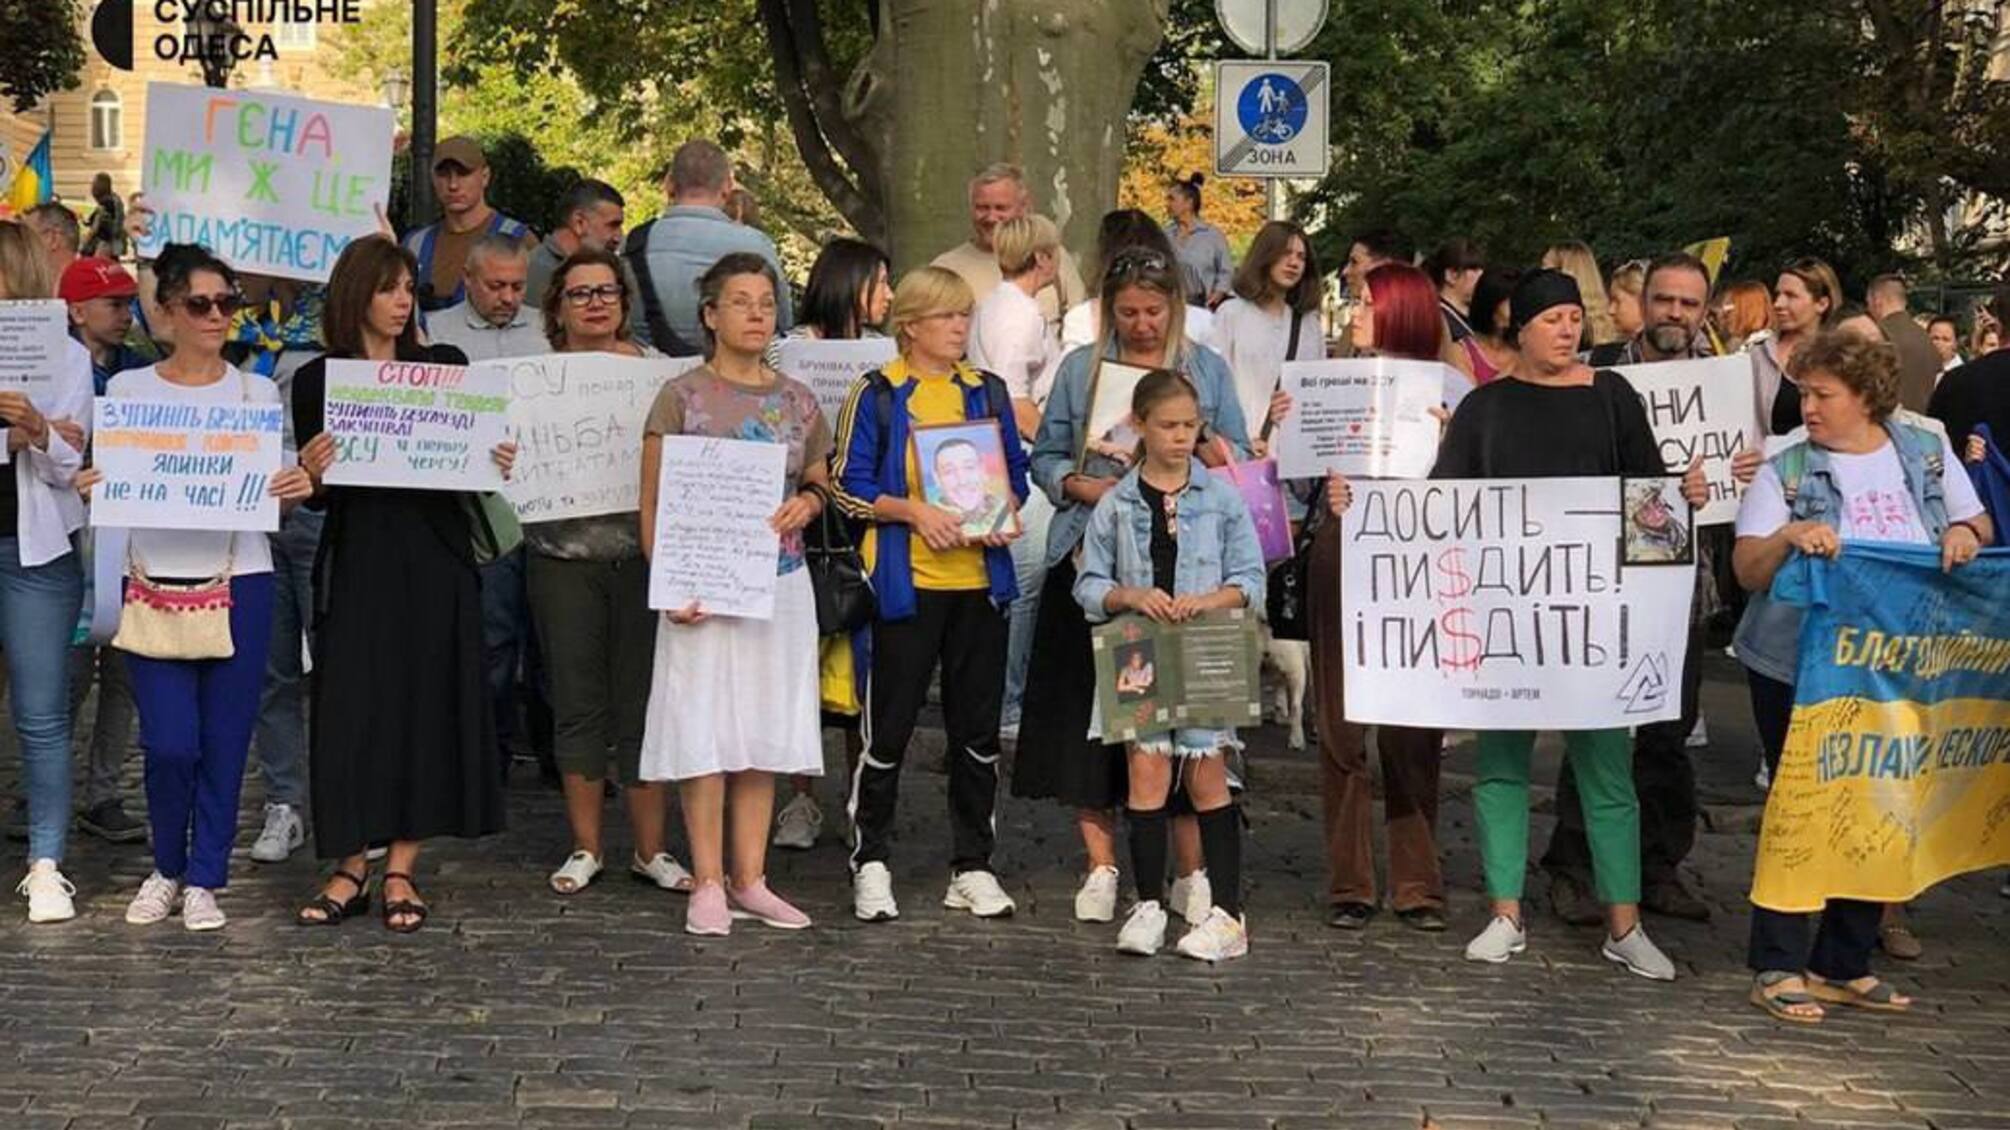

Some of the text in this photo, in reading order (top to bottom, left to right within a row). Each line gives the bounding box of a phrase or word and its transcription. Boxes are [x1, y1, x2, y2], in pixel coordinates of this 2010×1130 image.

[153, 149, 376, 217] МИ Ж ЦЕ
[1248, 150, 1297, 165] ЗОНА
[140, 481, 168, 501] НА
[185, 482, 227, 508] ЧАСІ
[1354, 484, 1545, 543] ДОСИТЬ
[1370, 536, 1623, 606] ПИ$ДИТЬ!
